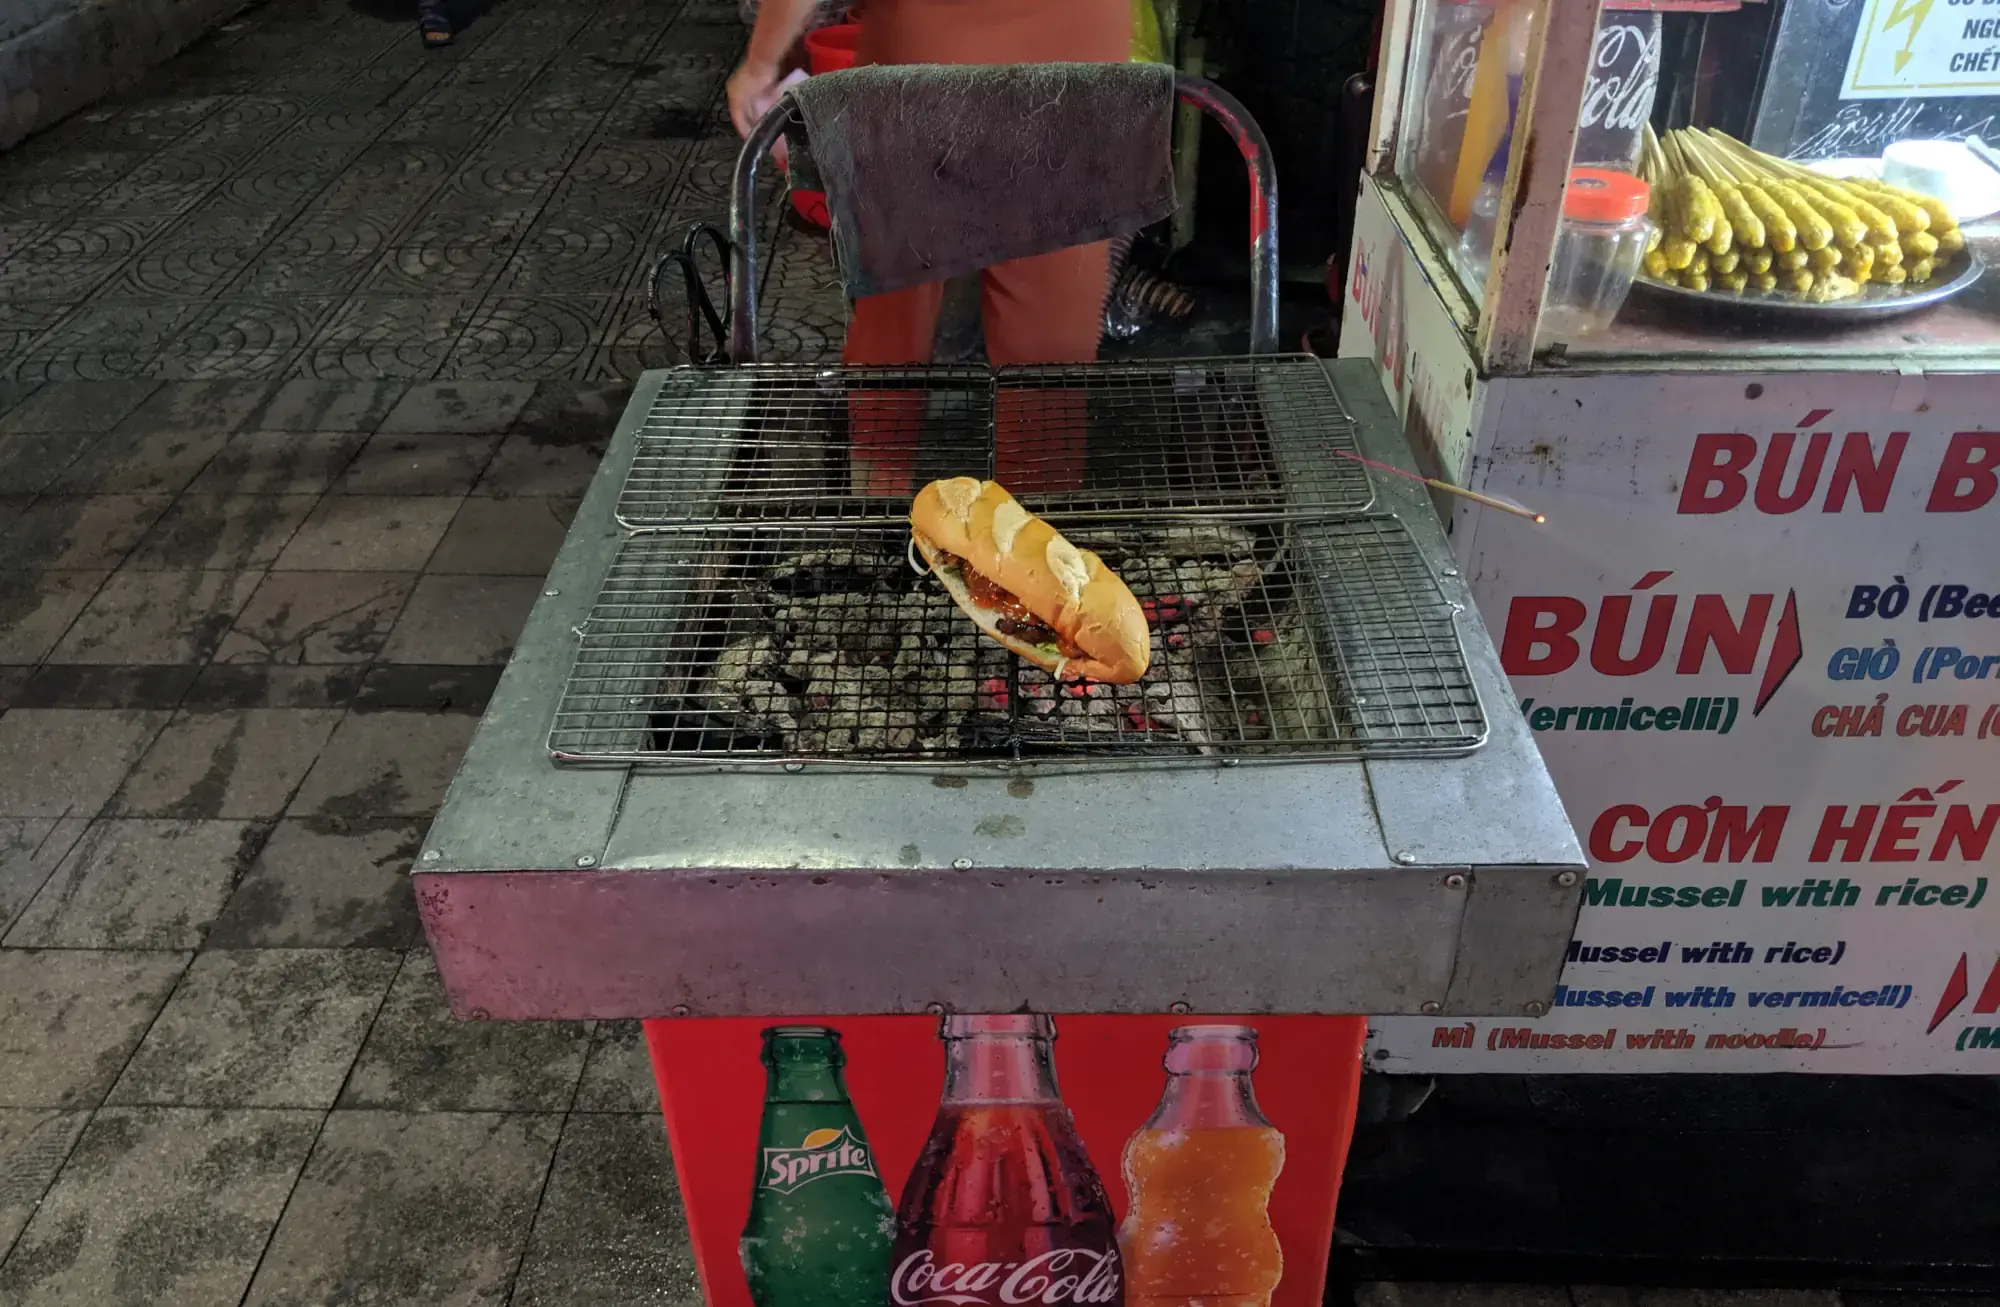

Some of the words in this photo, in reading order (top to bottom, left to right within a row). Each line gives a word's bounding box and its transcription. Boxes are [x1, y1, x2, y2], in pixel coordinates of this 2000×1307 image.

[1677, 409, 1910, 514] BÚN
[1845, 575, 1910, 619] BÒ
[1500, 571, 1774, 676] BÚN
[1827, 638, 1900, 681] GIÒ
[1912, 647, 2000, 684] (Por
[1811, 693, 1885, 737] CHẢ
[1896, 704, 1969, 737] CUA
[1589, 796, 1791, 863] CƠM
[1808, 780, 2000, 862] HẾN
[1762, 878, 1861, 907] with
[1875, 877, 1988, 908] rice)
[1682, 942, 1754, 963] with
[1764, 941, 1846, 965] rice)
[1665, 986, 1736, 1008] with
[1432, 1022, 1476, 1048] MÌ
[1487, 1028, 1616, 1051] (Mussel
[1626, 1028, 1695, 1049] with
[1705, 1028, 1827, 1051] noodle)
[768, 1137, 867, 1186] Sprite
[891, 1249, 1119, 1306] Coca-Cola
